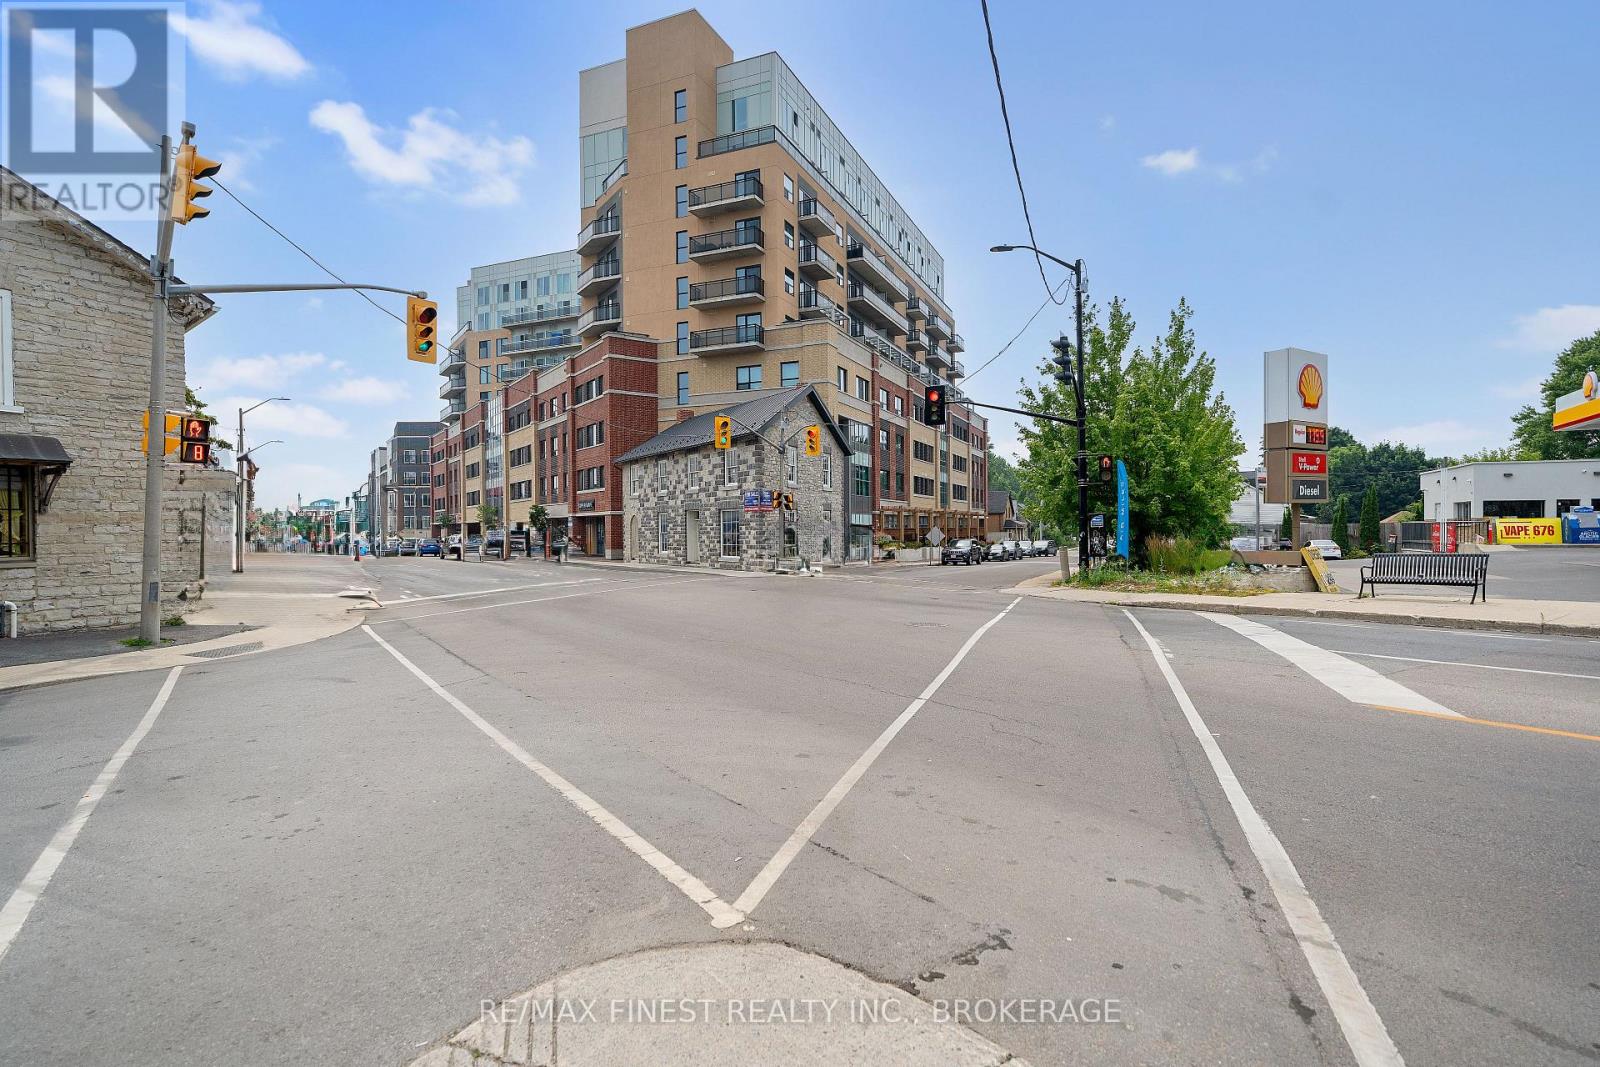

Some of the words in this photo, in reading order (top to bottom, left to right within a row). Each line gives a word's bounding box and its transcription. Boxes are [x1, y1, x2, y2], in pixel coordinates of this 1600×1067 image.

[1300, 485, 1320, 496] Diesel
[1503, 525, 1530, 536] VAPE
[1533, 525, 1555, 536] 676
